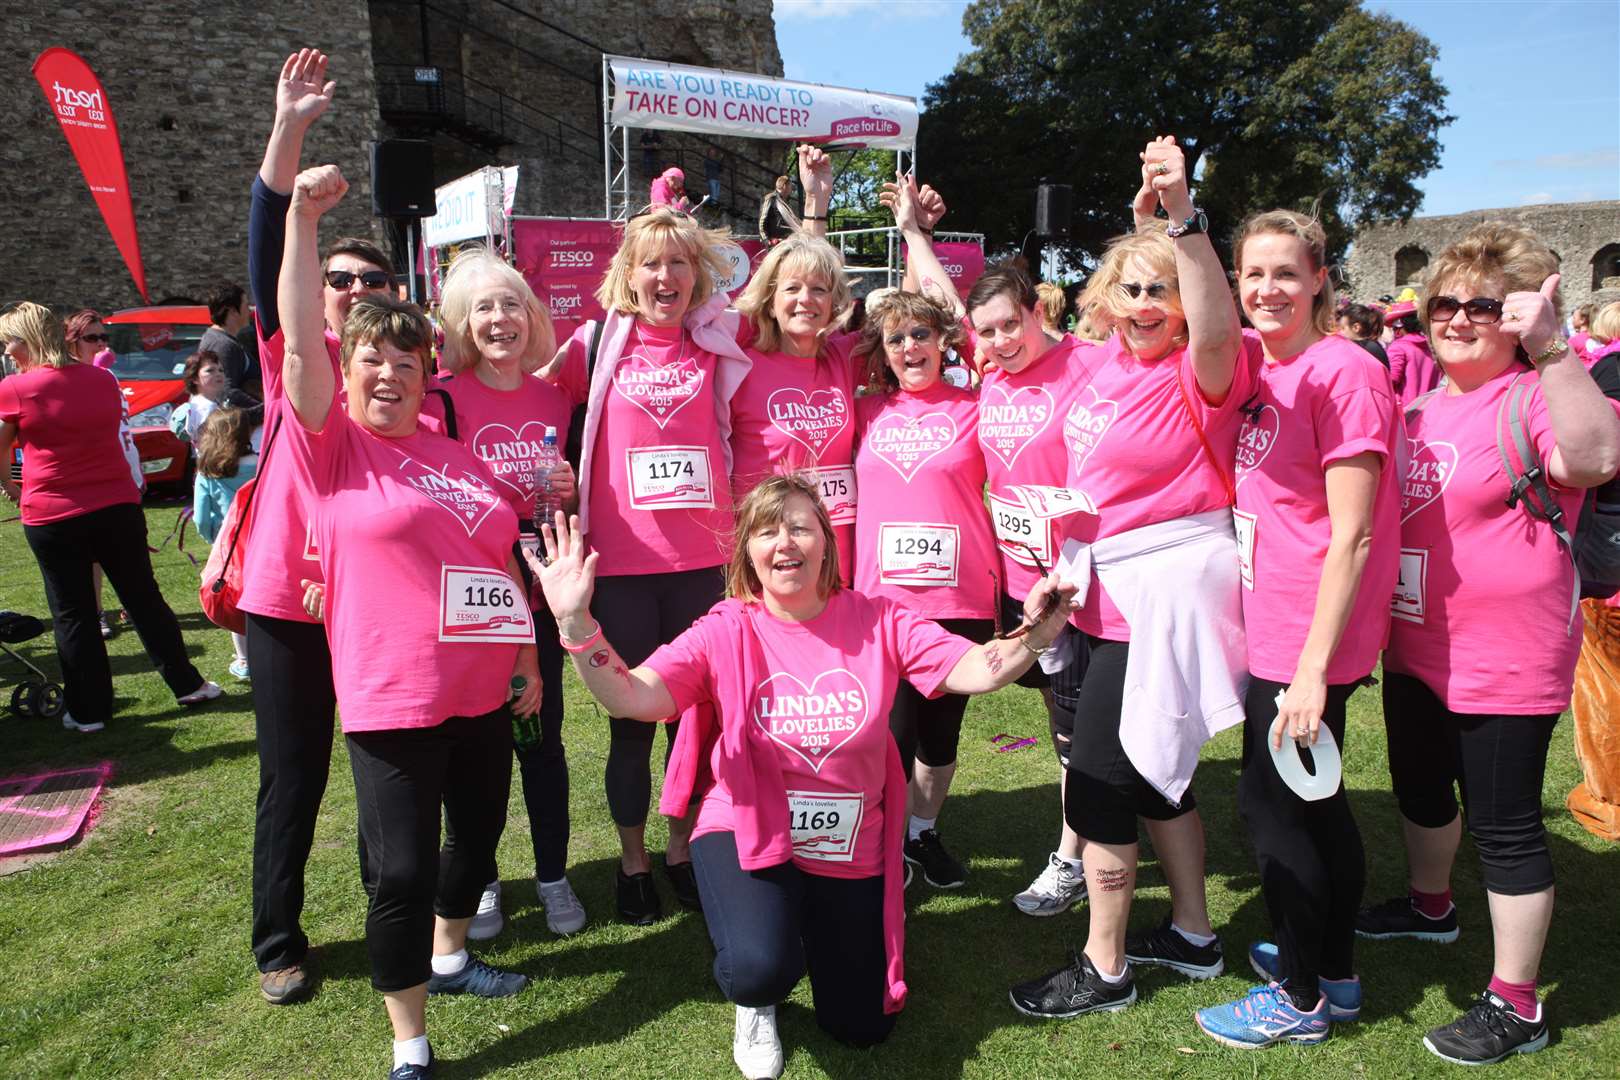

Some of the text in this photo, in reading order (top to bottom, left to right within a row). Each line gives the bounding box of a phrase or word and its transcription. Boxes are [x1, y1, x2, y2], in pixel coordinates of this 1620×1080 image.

[626, 68, 813, 107] ARE YOU READY TO
[625, 91, 810, 128] TAKE ON CANCER?
[836, 121, 893, 136] Race for Life
[445, 196, 462, 227] DID
[466, 190, 476, 223] IT
[550, 251, 594, 262] TESCO
[943, 264, 963, 273] SCO
[550, 293, 582, 308] heart
[618, 368, 699, 385] LINDA'S
[627, 384, 693, 396] LOVELIES
[649, 397, 673, 406] 2015
[773, 397, 846, 421] LINDA'S
[980, 404, 1047, 424] LINDA'S
[786, 415, 843, 432] LOVELIES
[979, 423, 1034, 438] LOVELIES
[808, 430, 828, 440] 2015
[871, 426, 951, 443] LINDA'S
[480, 440, 546, 462] LINDA'
[875, 440, 941, 453] LOVELIES
[996, 438, 1016, 449] 2015
[896, 452, 920, 462] 2015
[518, 473, 534, 483] 201
[649, 461, 694, 479] 1174
[1406, 460, 1449, 483] DA'S
[822, 479, 849, 498] 175
[1403, 483, 1433, 499] LIES
[998, 511, 1031, 535] 1295
[894, 538, 943, 556] 1294
[471, 576, 489, 584] Linda's
[464, 585, 514, 608] 1166
[761, 689, 863, 718] LINDA'S
[771, 715, 856, 735] LOVELIES
[800, 734, 830, 747] 2015
[790, 811, 840, 831] 1169
